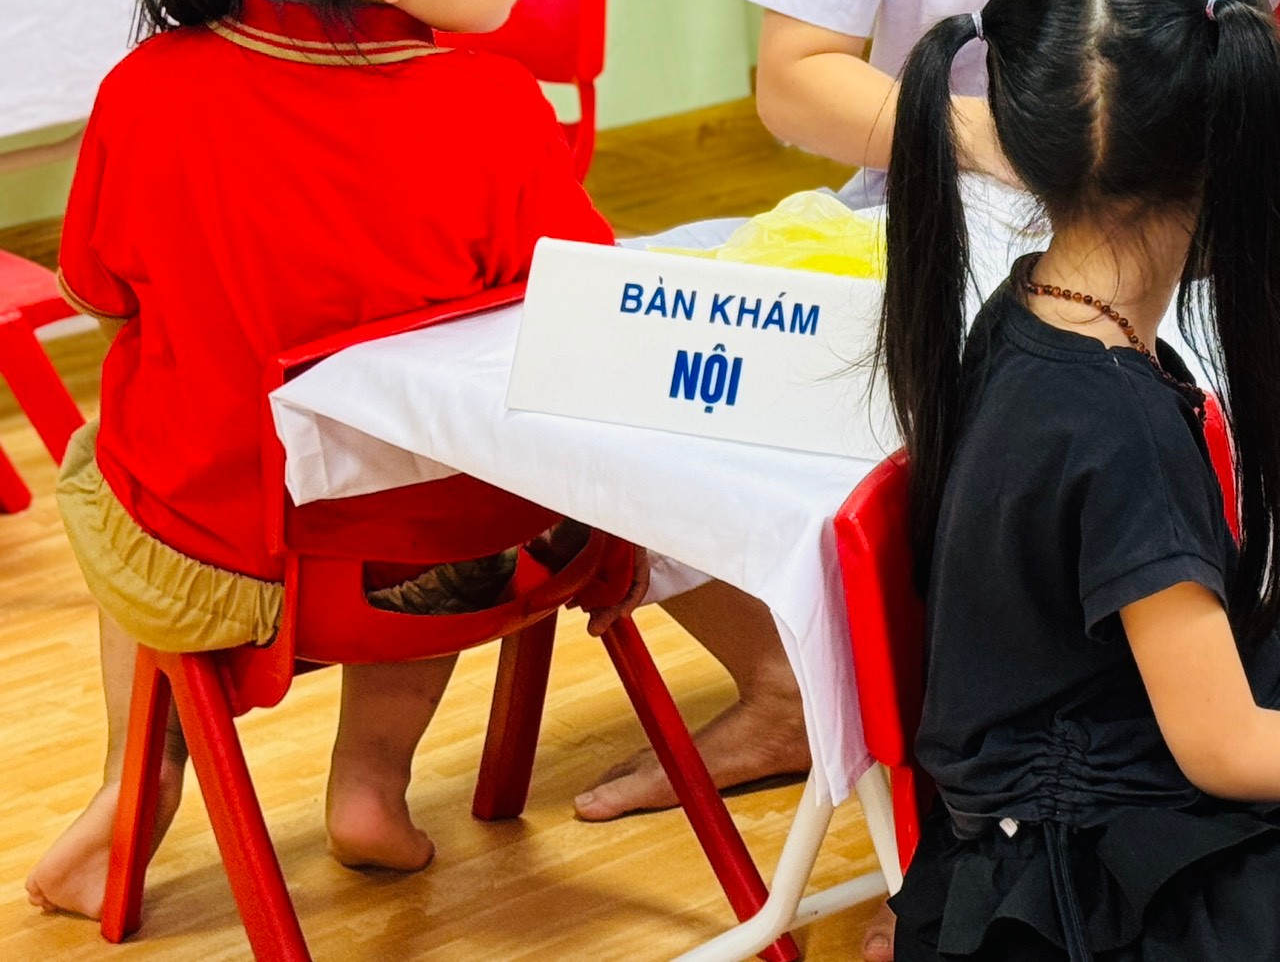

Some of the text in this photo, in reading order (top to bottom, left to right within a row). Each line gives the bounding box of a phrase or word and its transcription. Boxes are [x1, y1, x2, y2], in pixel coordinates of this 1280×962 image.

[619, 275, 820, 336] BÀN KHÁM
[668, 343, 743, 414] NỘI
